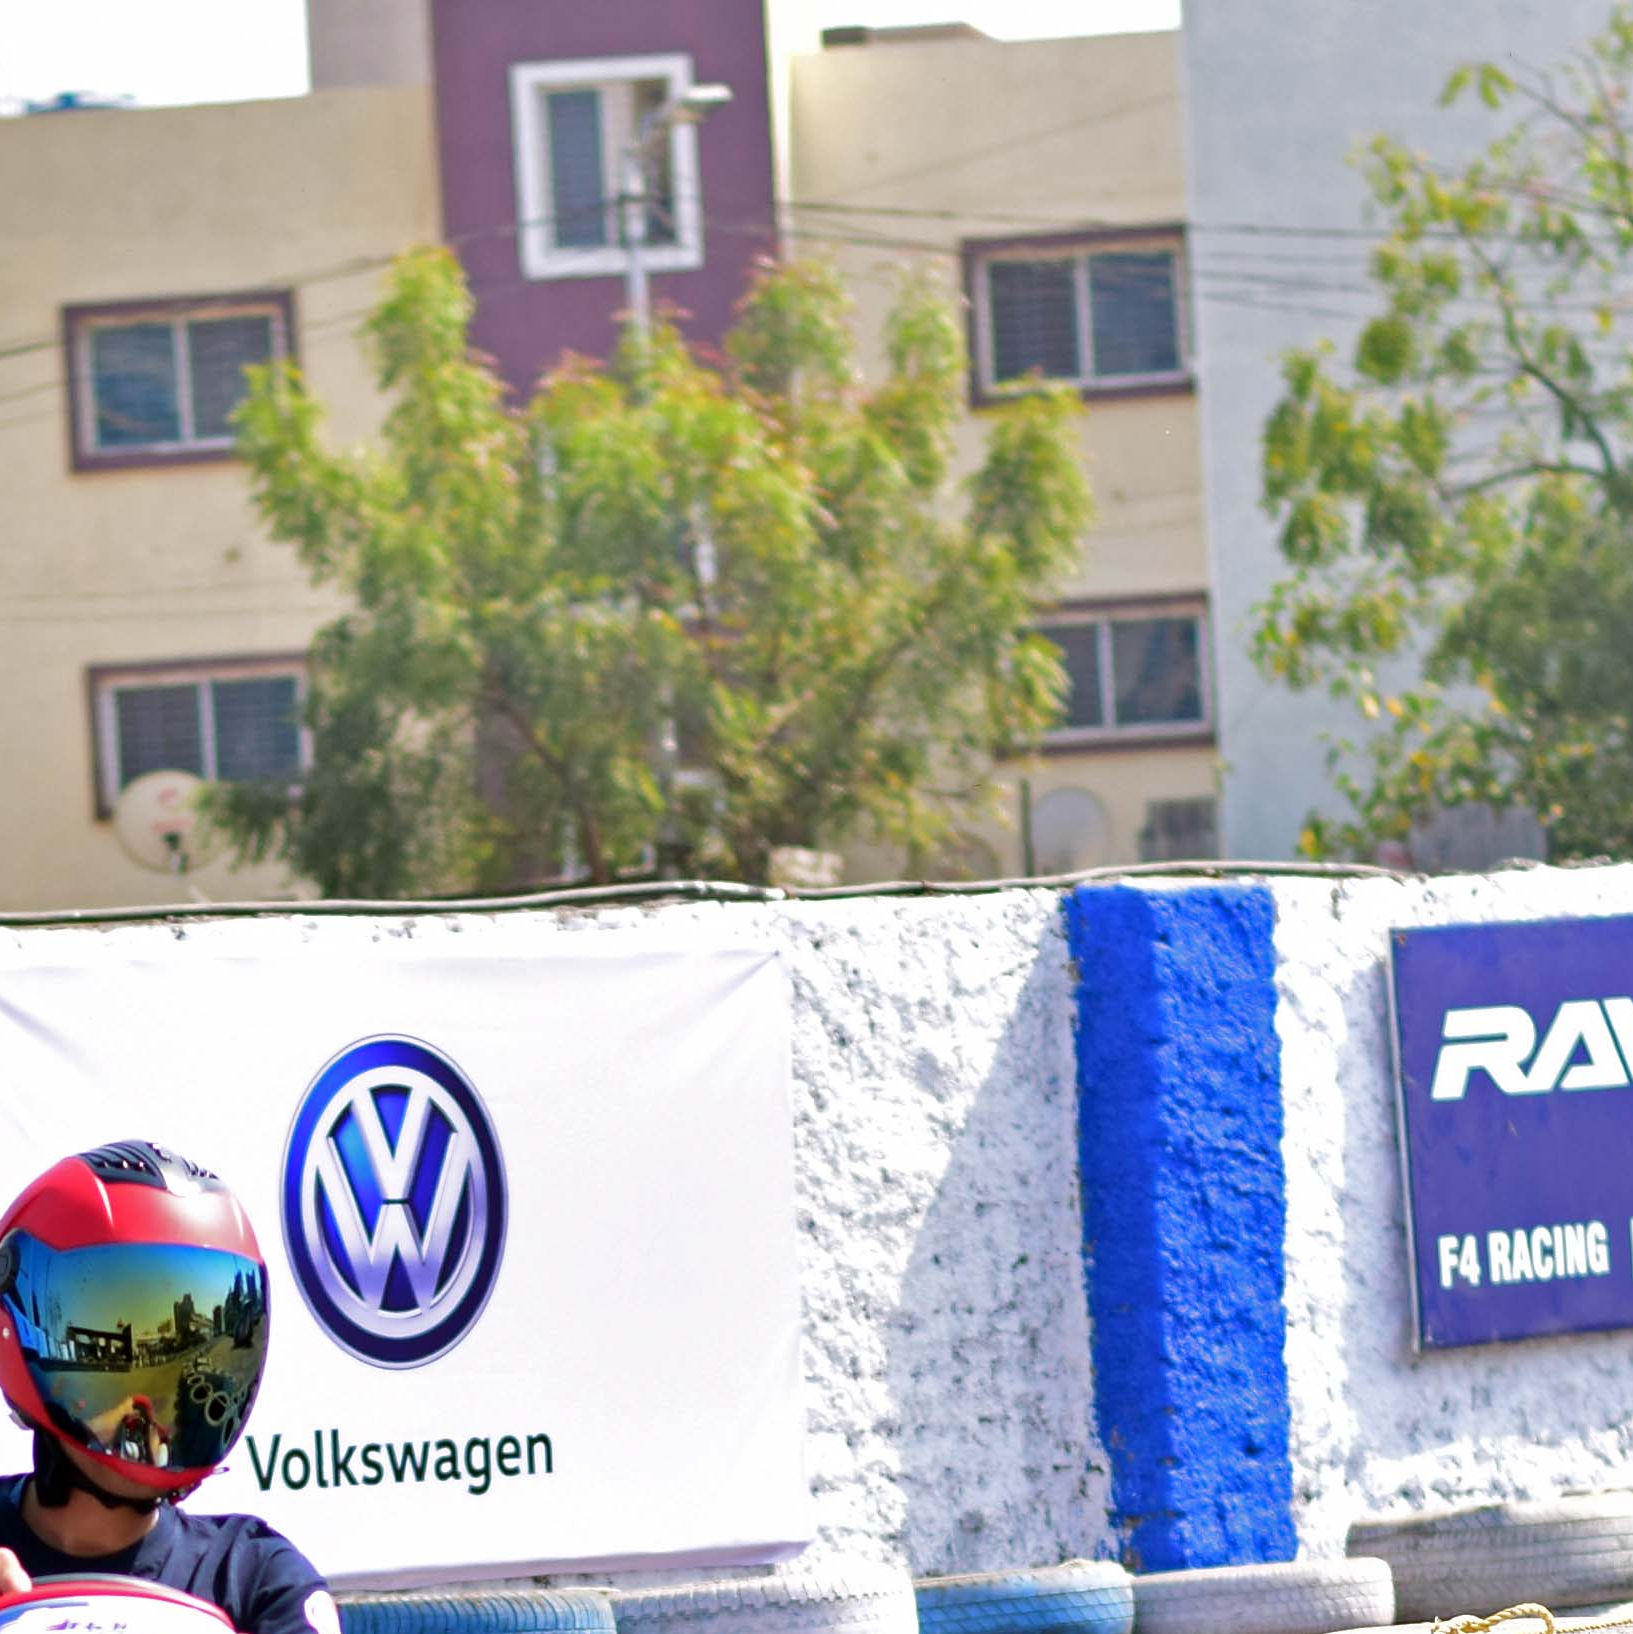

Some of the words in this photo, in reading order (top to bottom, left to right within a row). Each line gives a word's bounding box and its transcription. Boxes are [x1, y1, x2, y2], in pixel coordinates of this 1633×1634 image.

[1440, 1234, 1479, 1289] F4
[1489, 1219, 1610, 1285] RACING
[246, 1430, 554, 1495] Volkswagen
